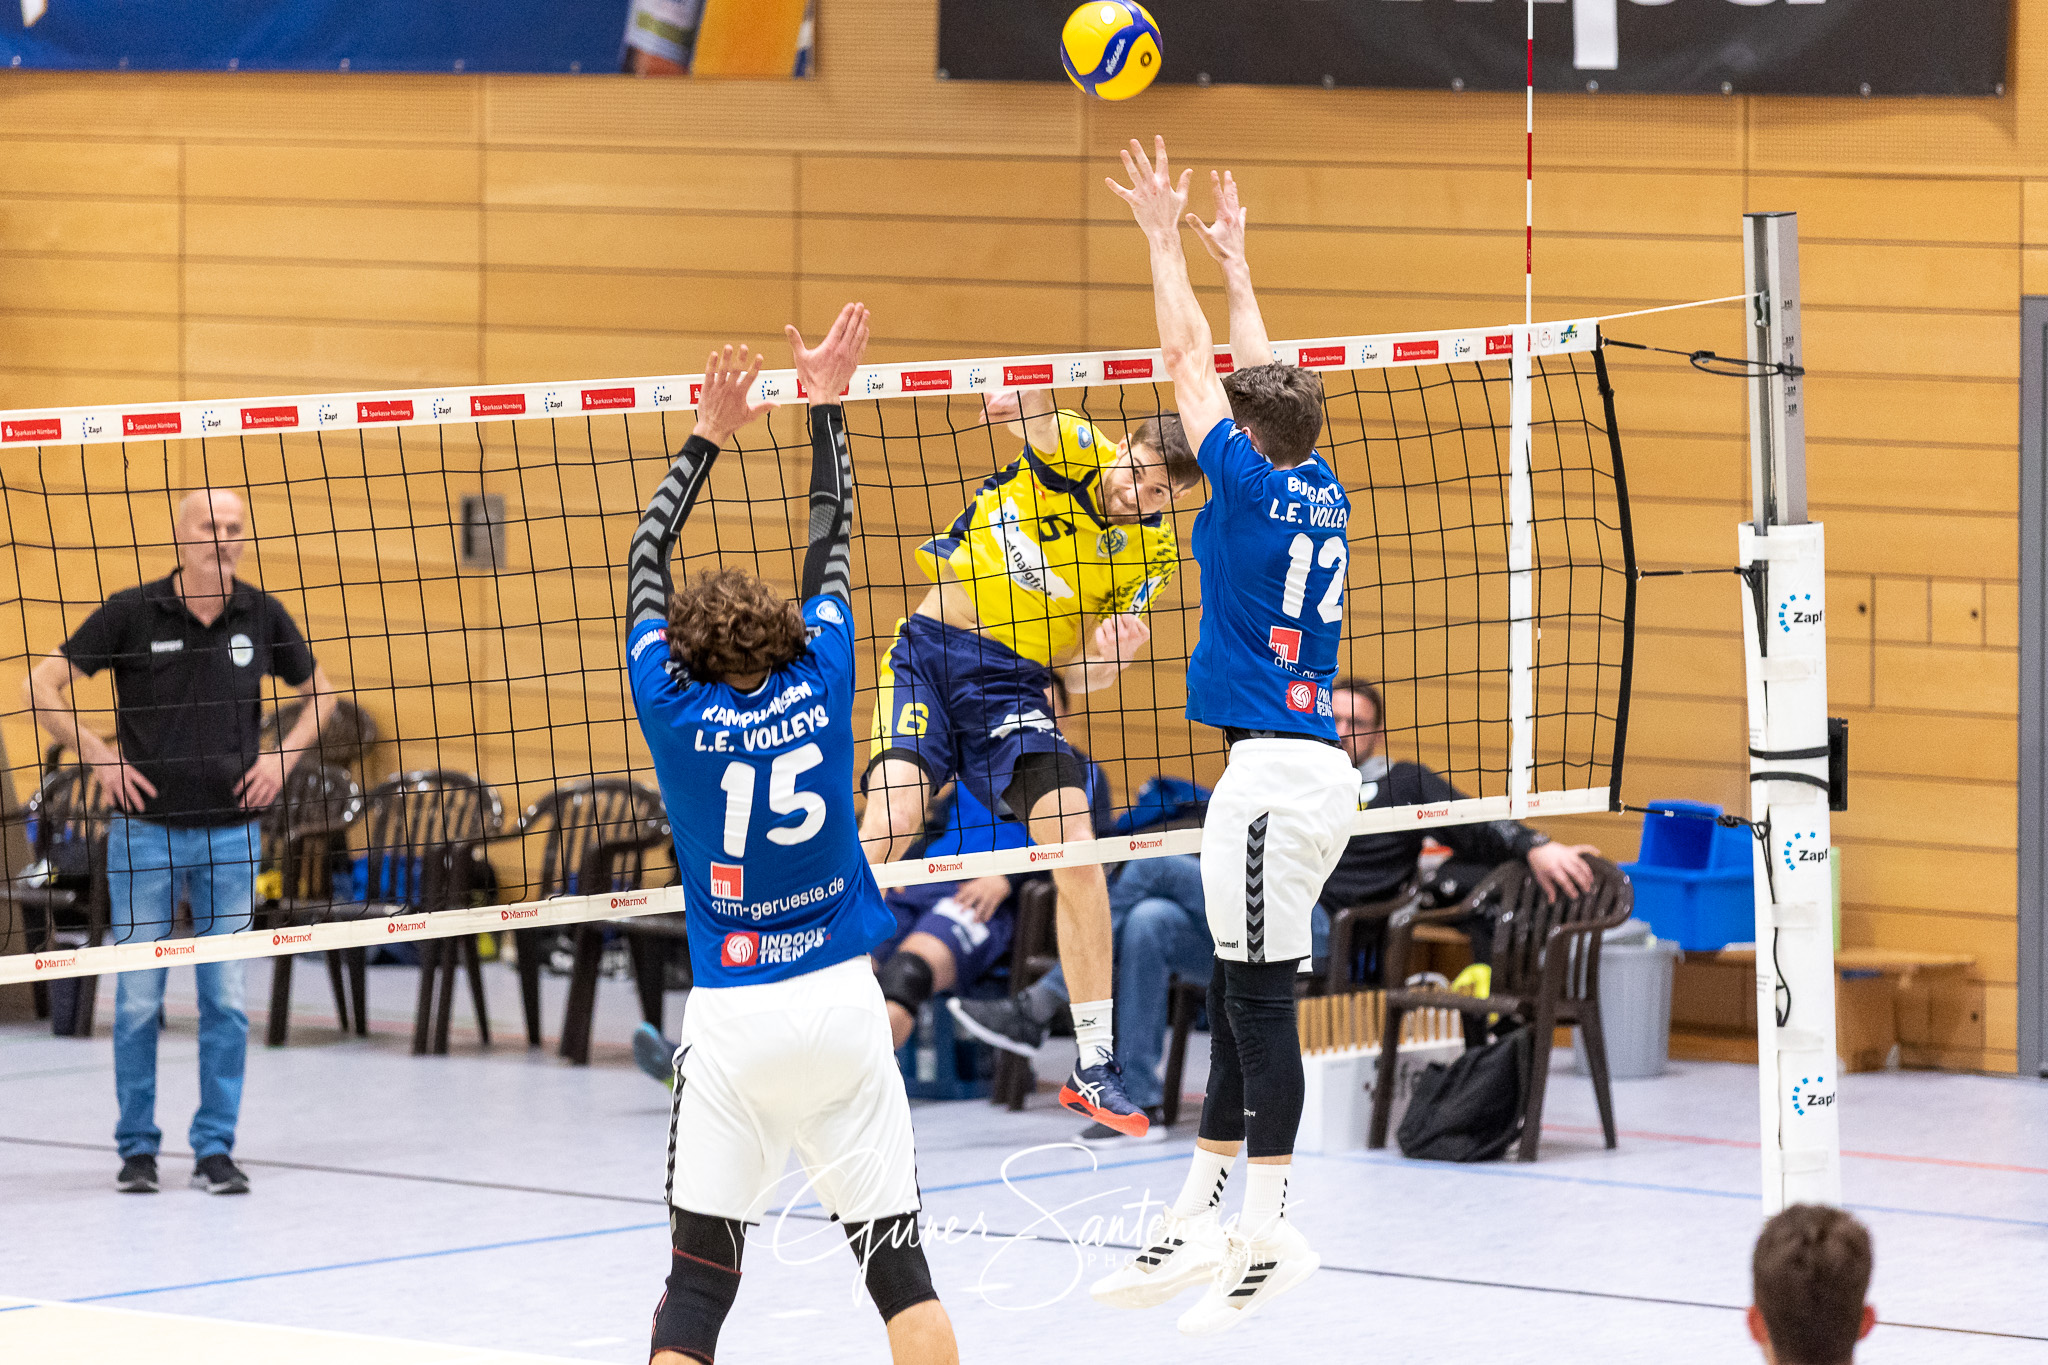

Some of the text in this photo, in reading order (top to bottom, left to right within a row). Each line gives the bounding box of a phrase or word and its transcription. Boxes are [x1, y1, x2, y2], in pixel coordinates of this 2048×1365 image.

[1459, 345, 1470, 354] Zapf
[1366, 351, 1377, 360] Zapf
[1014, 373, 1032, 382] Sparkasse
[1075, 370, 1087, 379] Zapf
[872, 381, 884, 390] Zapf
[974, 376, 986, 385] Zapf
[767, 387, 779, 396] Zapf
[593, 396, 613, 405] Sparkasse
[659, 394, 672, 402] Zapf
[482, 402, 503, 411] Sparkasse
[550, 400, 563, 409] Zapf
[369, 409, 390, 418] Sparkasse
[438, 406, 452, 415] Zapf
[324, 411, 338, 421] Zapf
[208, 419, 221, 429] Zapf
[88, 425, 102, 435] Zapf
[1269, 498, 1303, 524] L.E.
[1282, 532, 1348, 624] 12
[1793, 610, 1822, 625] Zapf
[701, 681, 813, 729] KAMPHAUSEN
[896, 702, 929, 739] 6
[694, 704, 830, 753] L.E. VOLLEYS
[720, 742, 827, 859] 15
[1423, 808, 1448, 818] Marmot
[1137, 839, 1163, 849] Marmot
[1037, 850, 1064, 860] Marmot
[1799, 848, 1828, 863] Zapf
[936, 861, 963, 872] Marmot
[618, 897, 647, 907] Marmot
[509, 909, 538, 919] Marmot
[396, 921, 426, 932] Marmot
[281, 933, 311, 944] Marmot
[164, 945, 195, 956] Marmot
[44, 957, 76, 968] Marmot
[1807, 1091, 1836, 1107] Zapf
